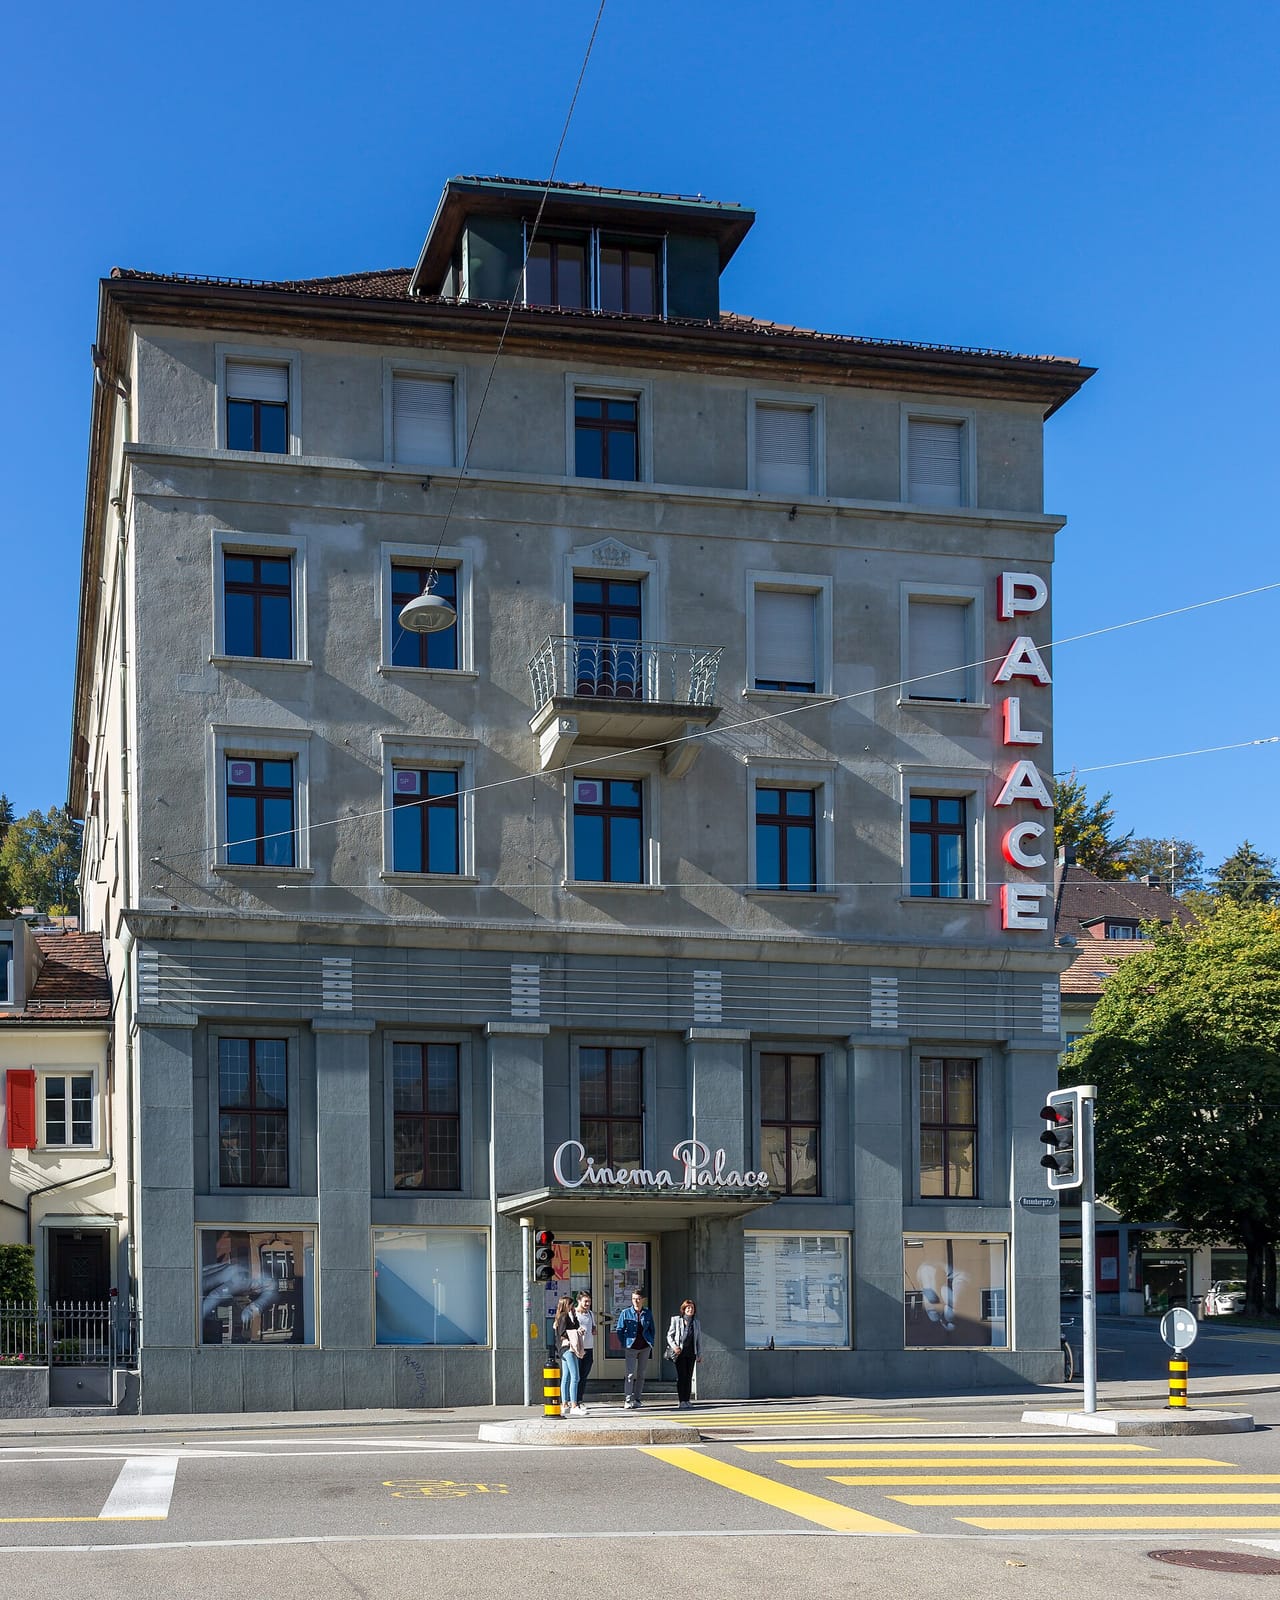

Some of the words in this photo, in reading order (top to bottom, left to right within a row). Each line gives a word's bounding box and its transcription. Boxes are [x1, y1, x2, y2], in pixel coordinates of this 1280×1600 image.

[994, 571, 1053, 930] PALACE
[553, 1140, 674, 1188] Cinema
[672, 1139, 770, 1190] Palace
